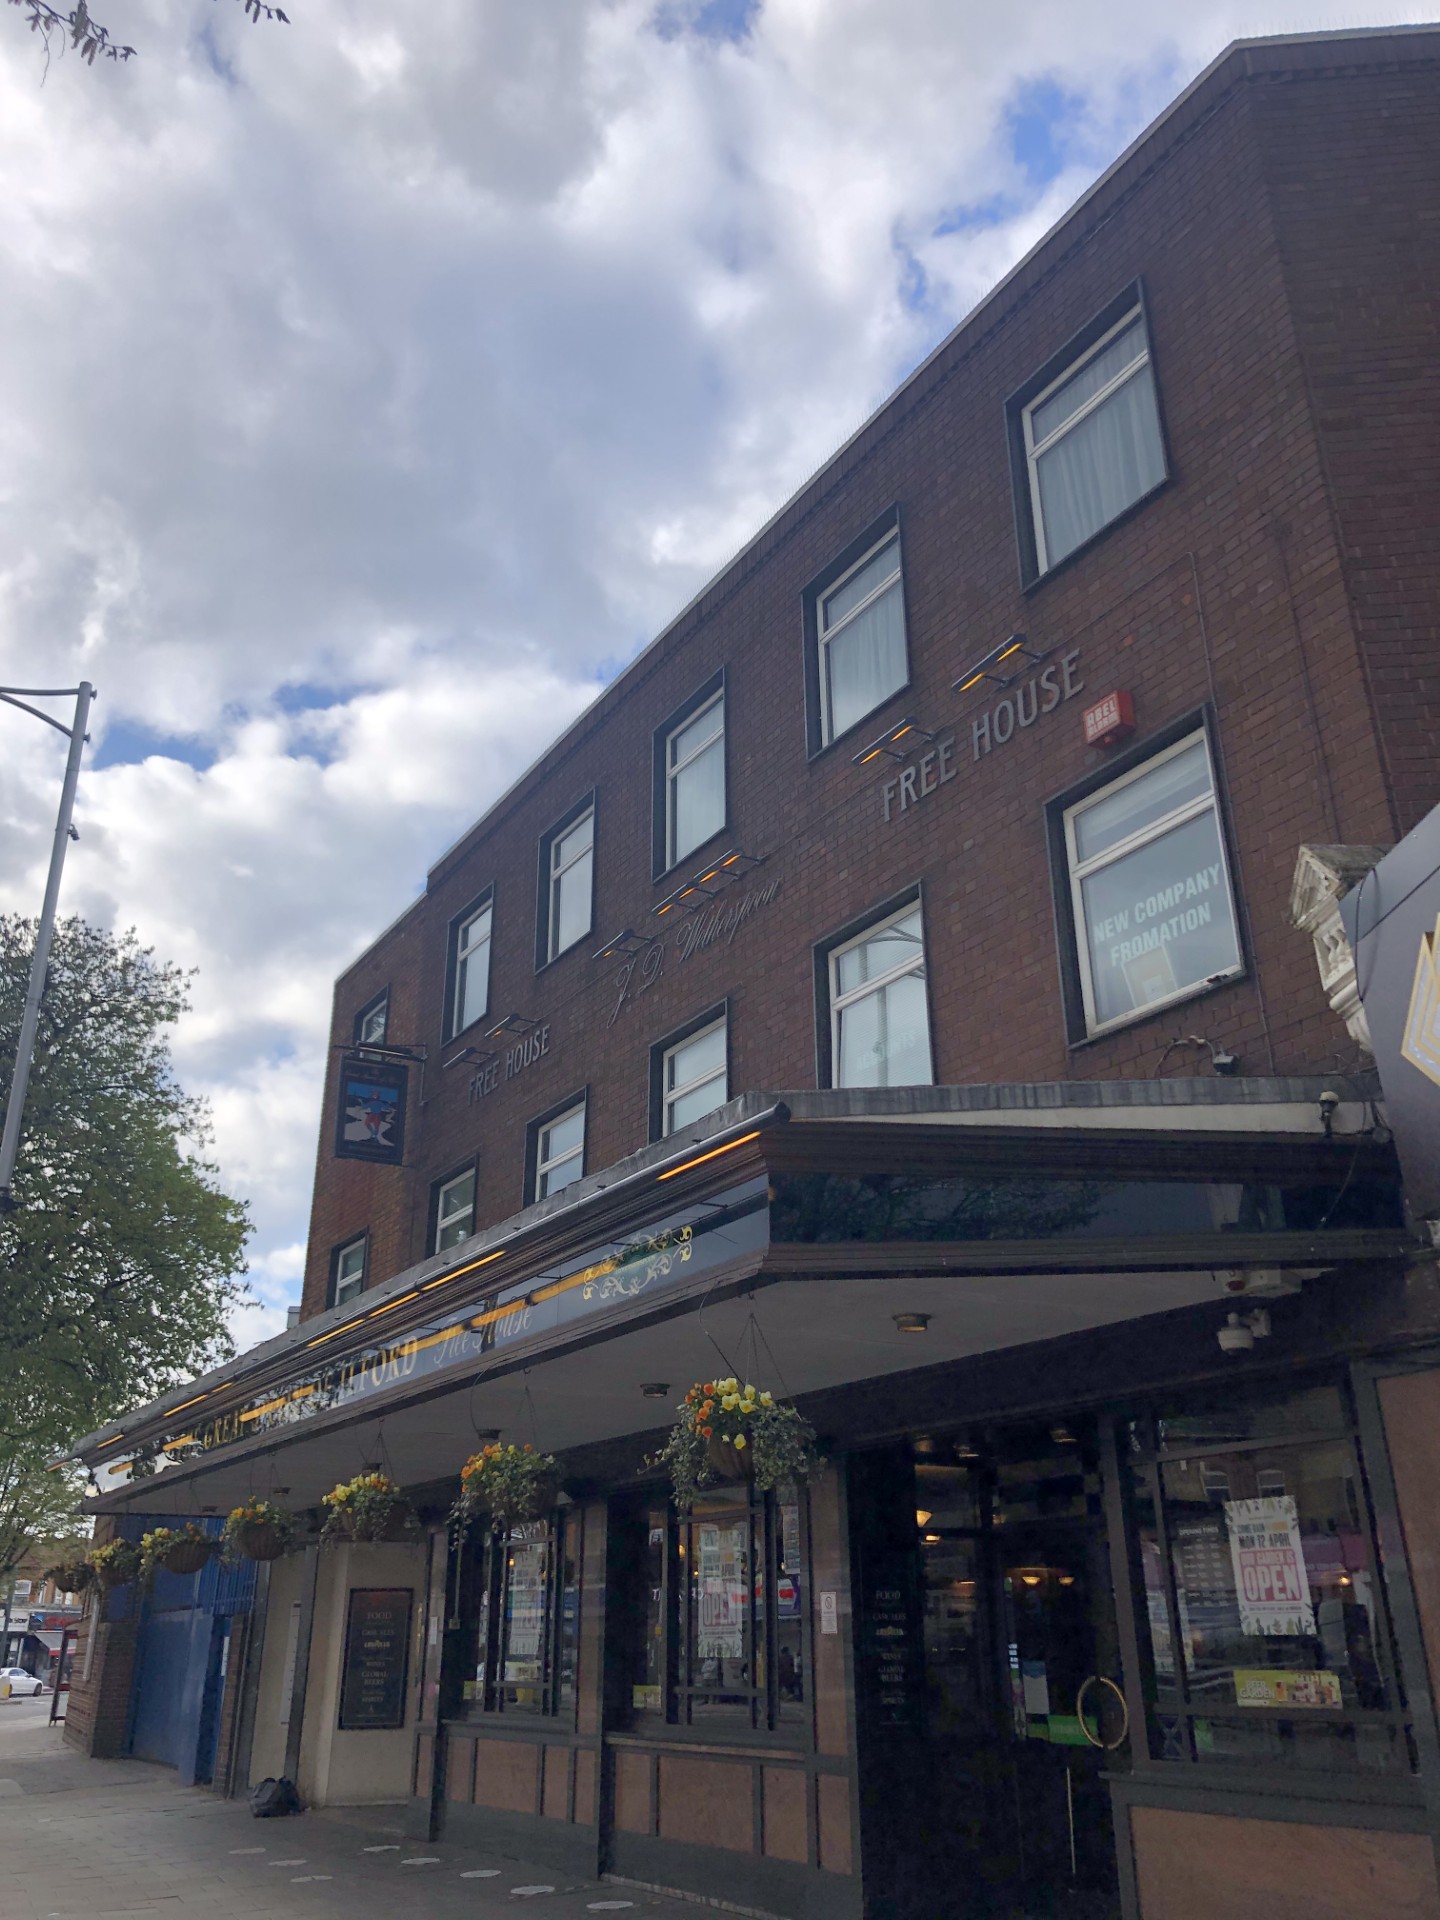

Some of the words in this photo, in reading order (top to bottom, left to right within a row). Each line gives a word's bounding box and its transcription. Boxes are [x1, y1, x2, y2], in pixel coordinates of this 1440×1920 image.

[882, 736, 957, 822] FREE
[971, 648, 1084, 761] HOUSE
[1092, 909, 1130, 944] NEW
[1134, 863, 1220, 924] COMPANY
[1110, 902, 1211, 967] FROMATION
[467, 1060, 499, 1106] FREE
[505, 1024, 550, 1080] HOUSE
[338, 1335, 417, 1400] ILFORD
[1239, 1535, 1255, 1549] MON
[1257, 1534, 1266, 1548] 12
[1269, 1532, 1291, 1547] APRIL
[1244, 1565, 1301, 1600] OPEN
[367, 1611, 393, 1620] FOOD
[703, 1592, 737, 1626] OPEN
[1240, 1688, 1275, 1699] GARDEN
